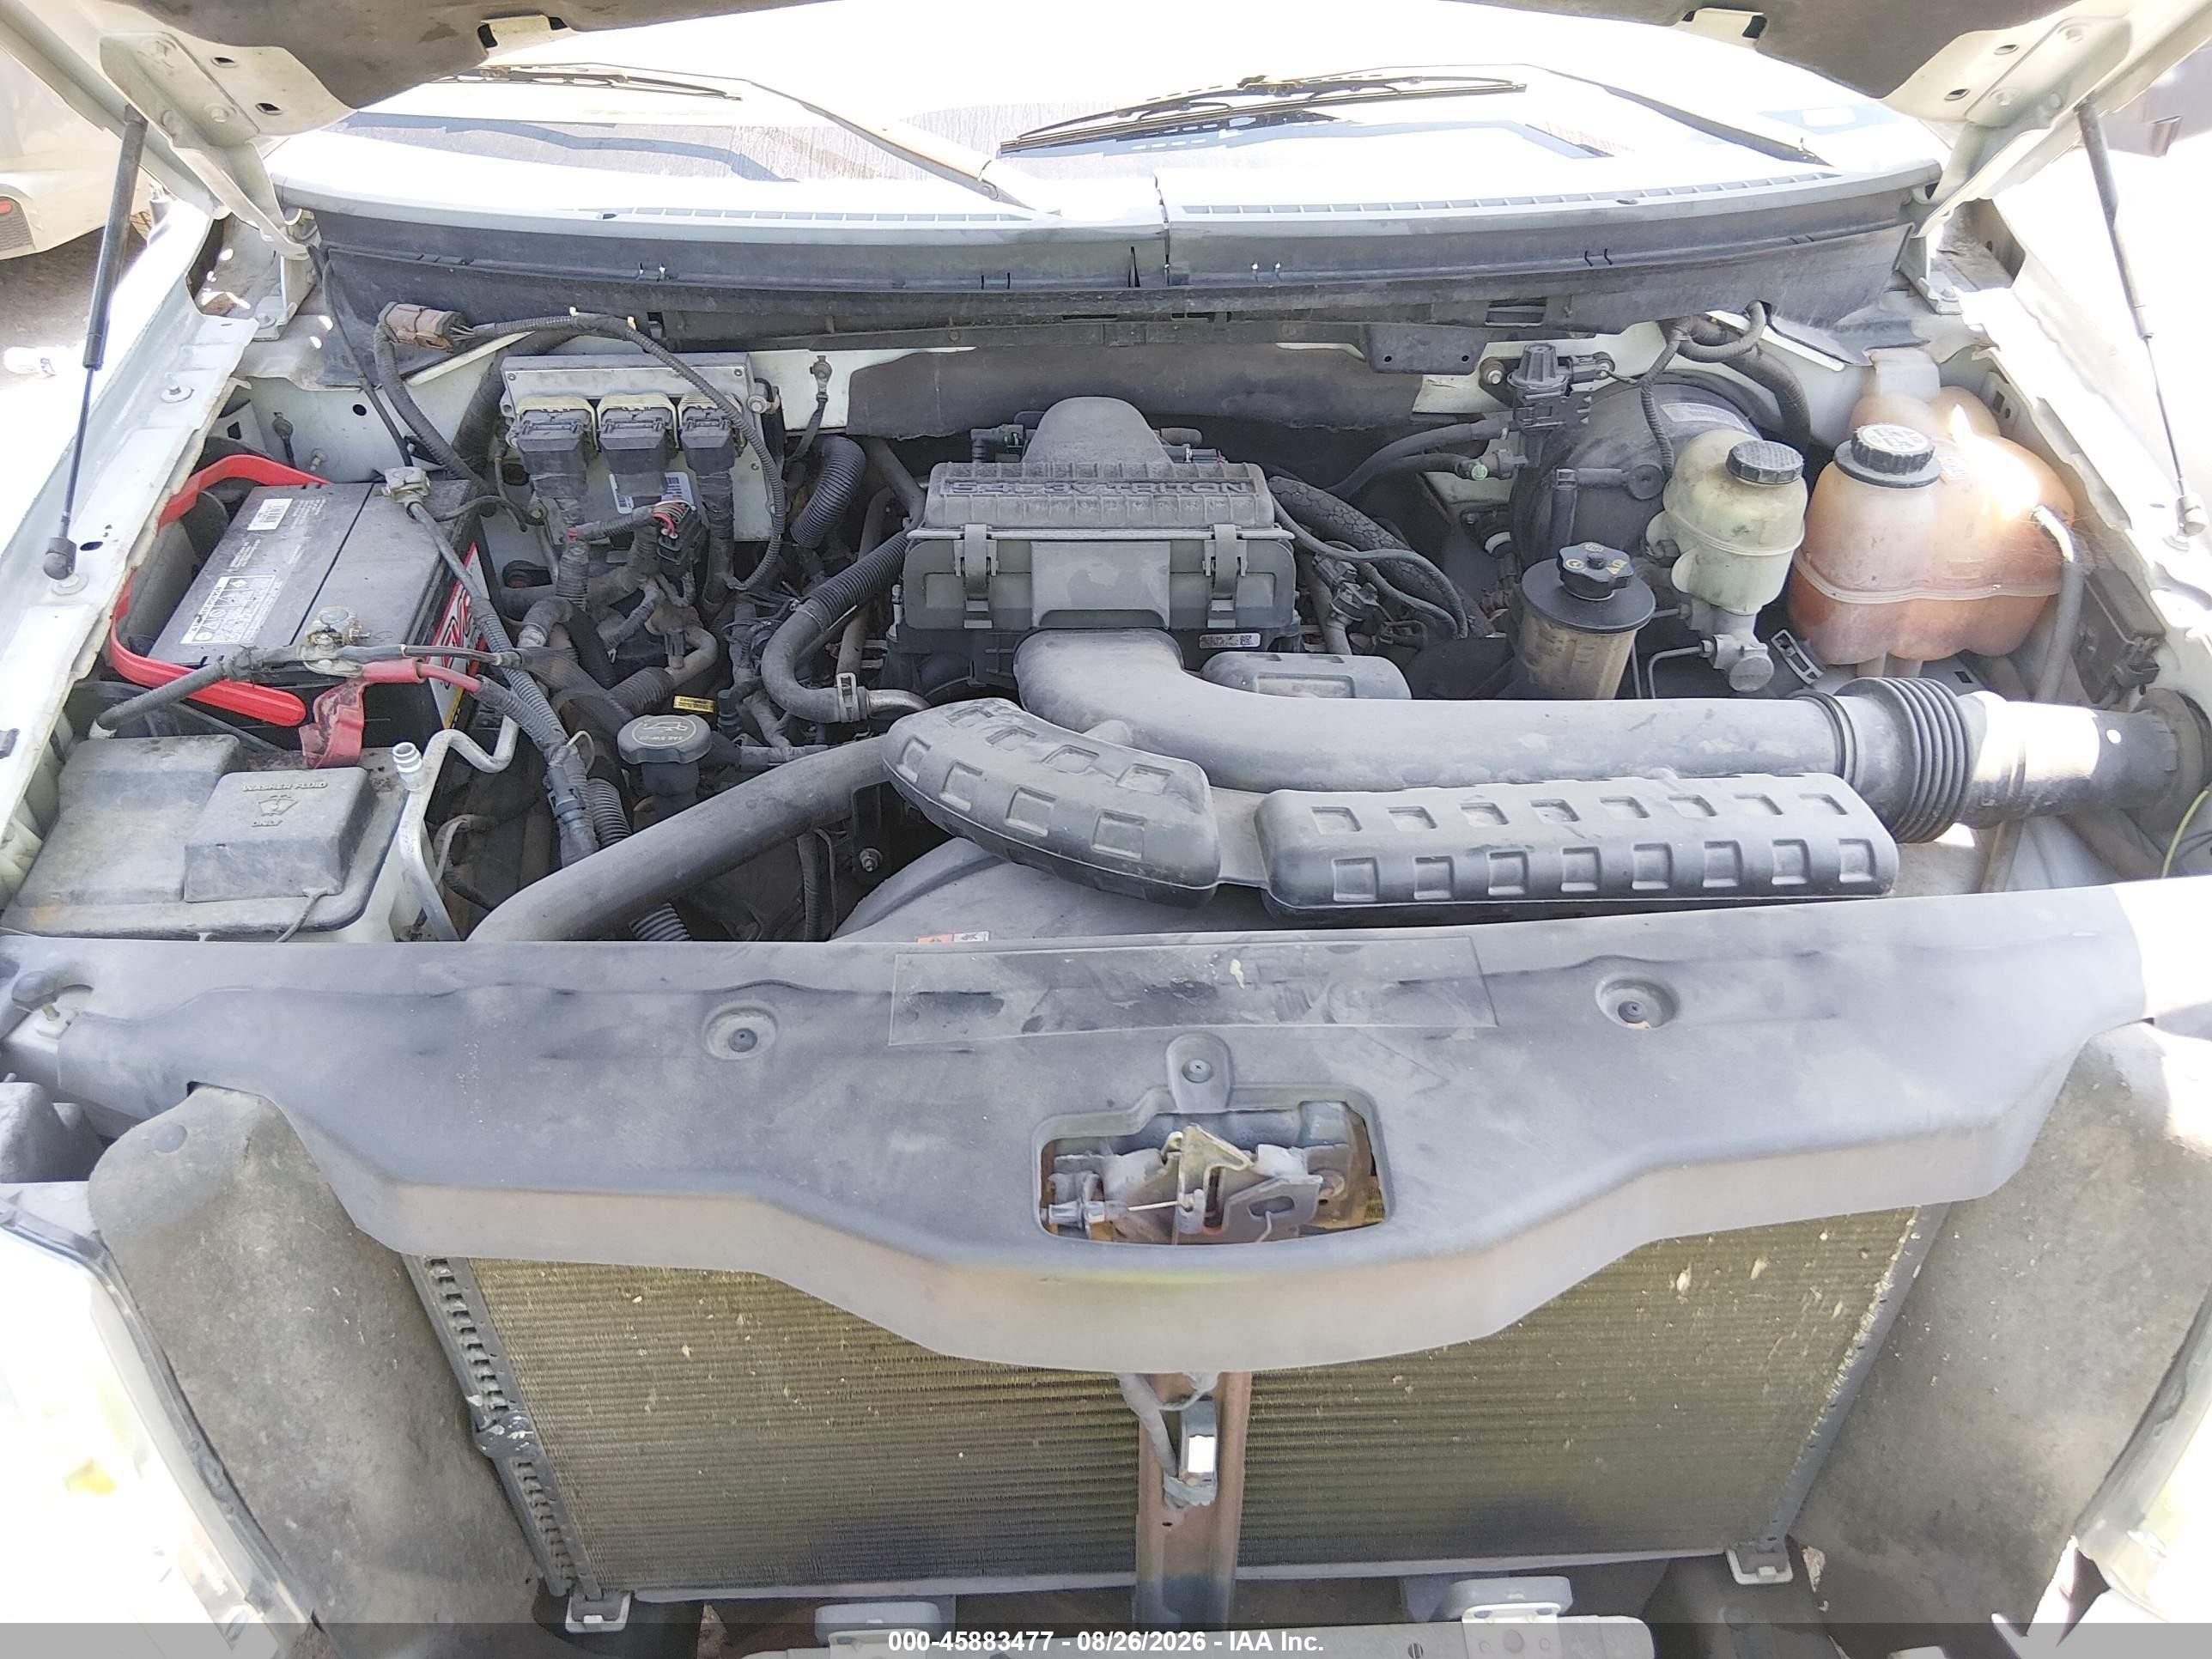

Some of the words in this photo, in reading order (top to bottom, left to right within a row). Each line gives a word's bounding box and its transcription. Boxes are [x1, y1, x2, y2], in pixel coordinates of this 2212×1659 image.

[951, 479, 1035, 494] 5.4L
[1042, 479, 1103, 494] 3V
[1104, 479, 1248, 495] TRITON
[242, 783, 293, 792] WASHER
[295, 781, 328, 790] FLUID
